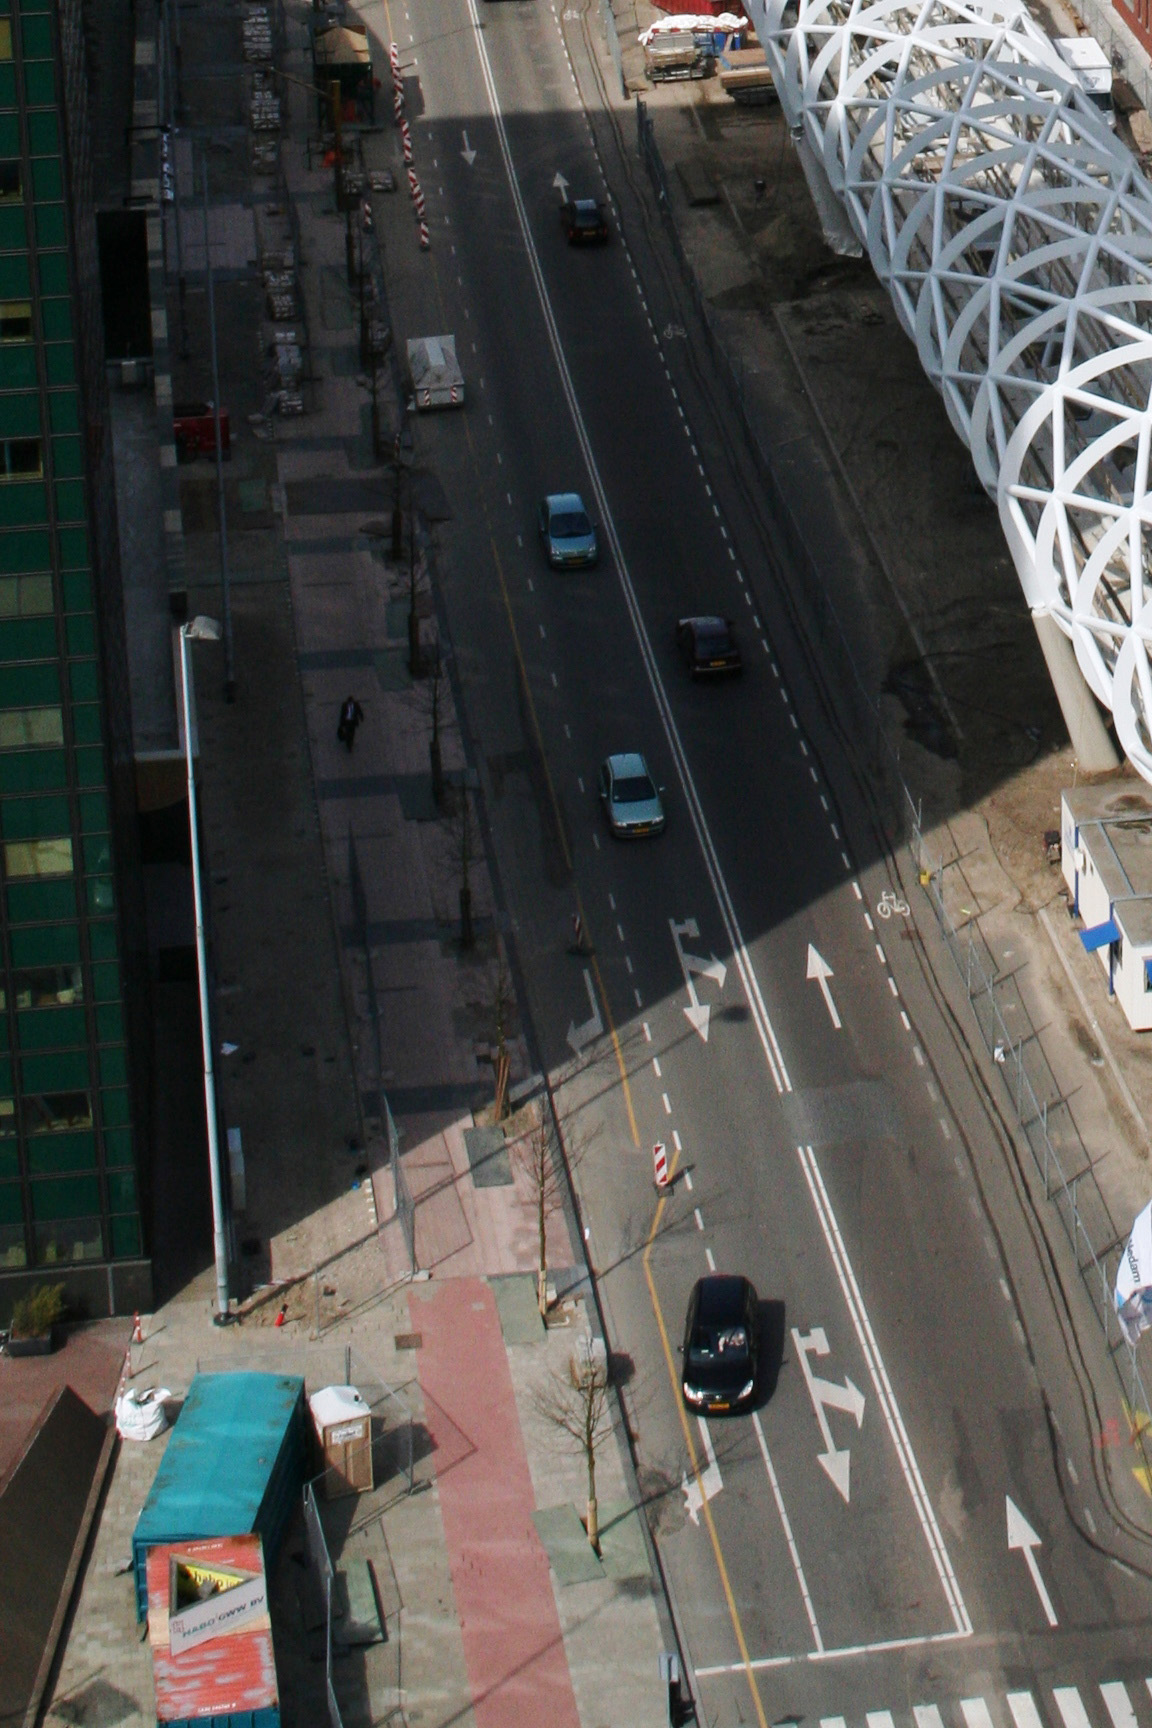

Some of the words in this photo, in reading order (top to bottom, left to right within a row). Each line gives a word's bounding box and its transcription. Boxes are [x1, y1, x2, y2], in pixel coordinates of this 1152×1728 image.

[183, 1618, 215, 1638] HABO
[218, 1603, 247, 1622] GWW
[250, 1595, 264, 1608] BV
